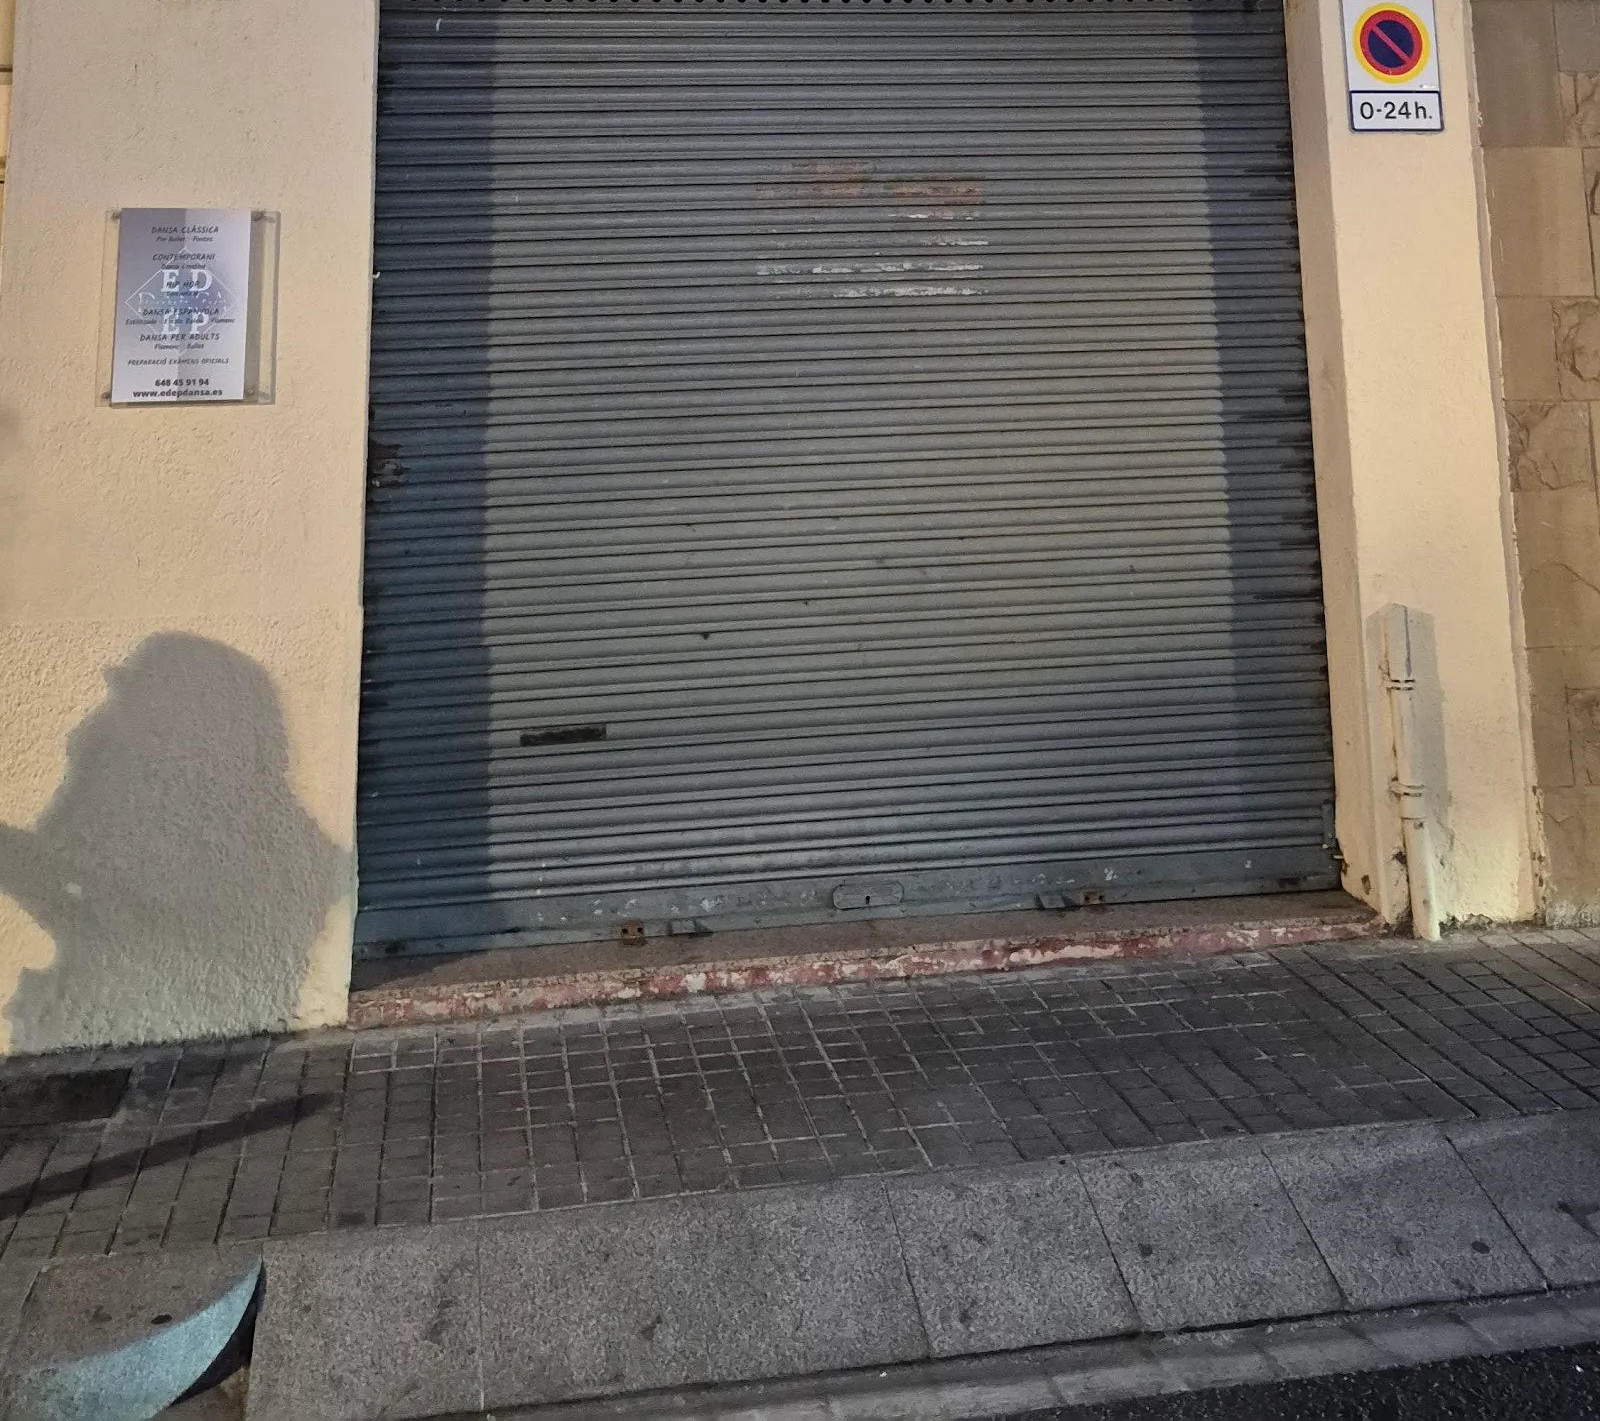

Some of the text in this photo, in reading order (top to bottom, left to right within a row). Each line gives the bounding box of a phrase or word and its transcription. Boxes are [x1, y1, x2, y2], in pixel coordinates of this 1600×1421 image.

[151, 224, 219, 234] DANSA CLÀSSICA
[152, 253, 216, 261] CONTEMPORANI
[142, 308, 170, 316] DANSA
[140, 333, 168, 342] DANSA
[189, 333, 221, 341] ADULTS
[154, 377, 210, 387] 648 45 91 94
[132, 388, 224, 399] www.edepdansa.es
